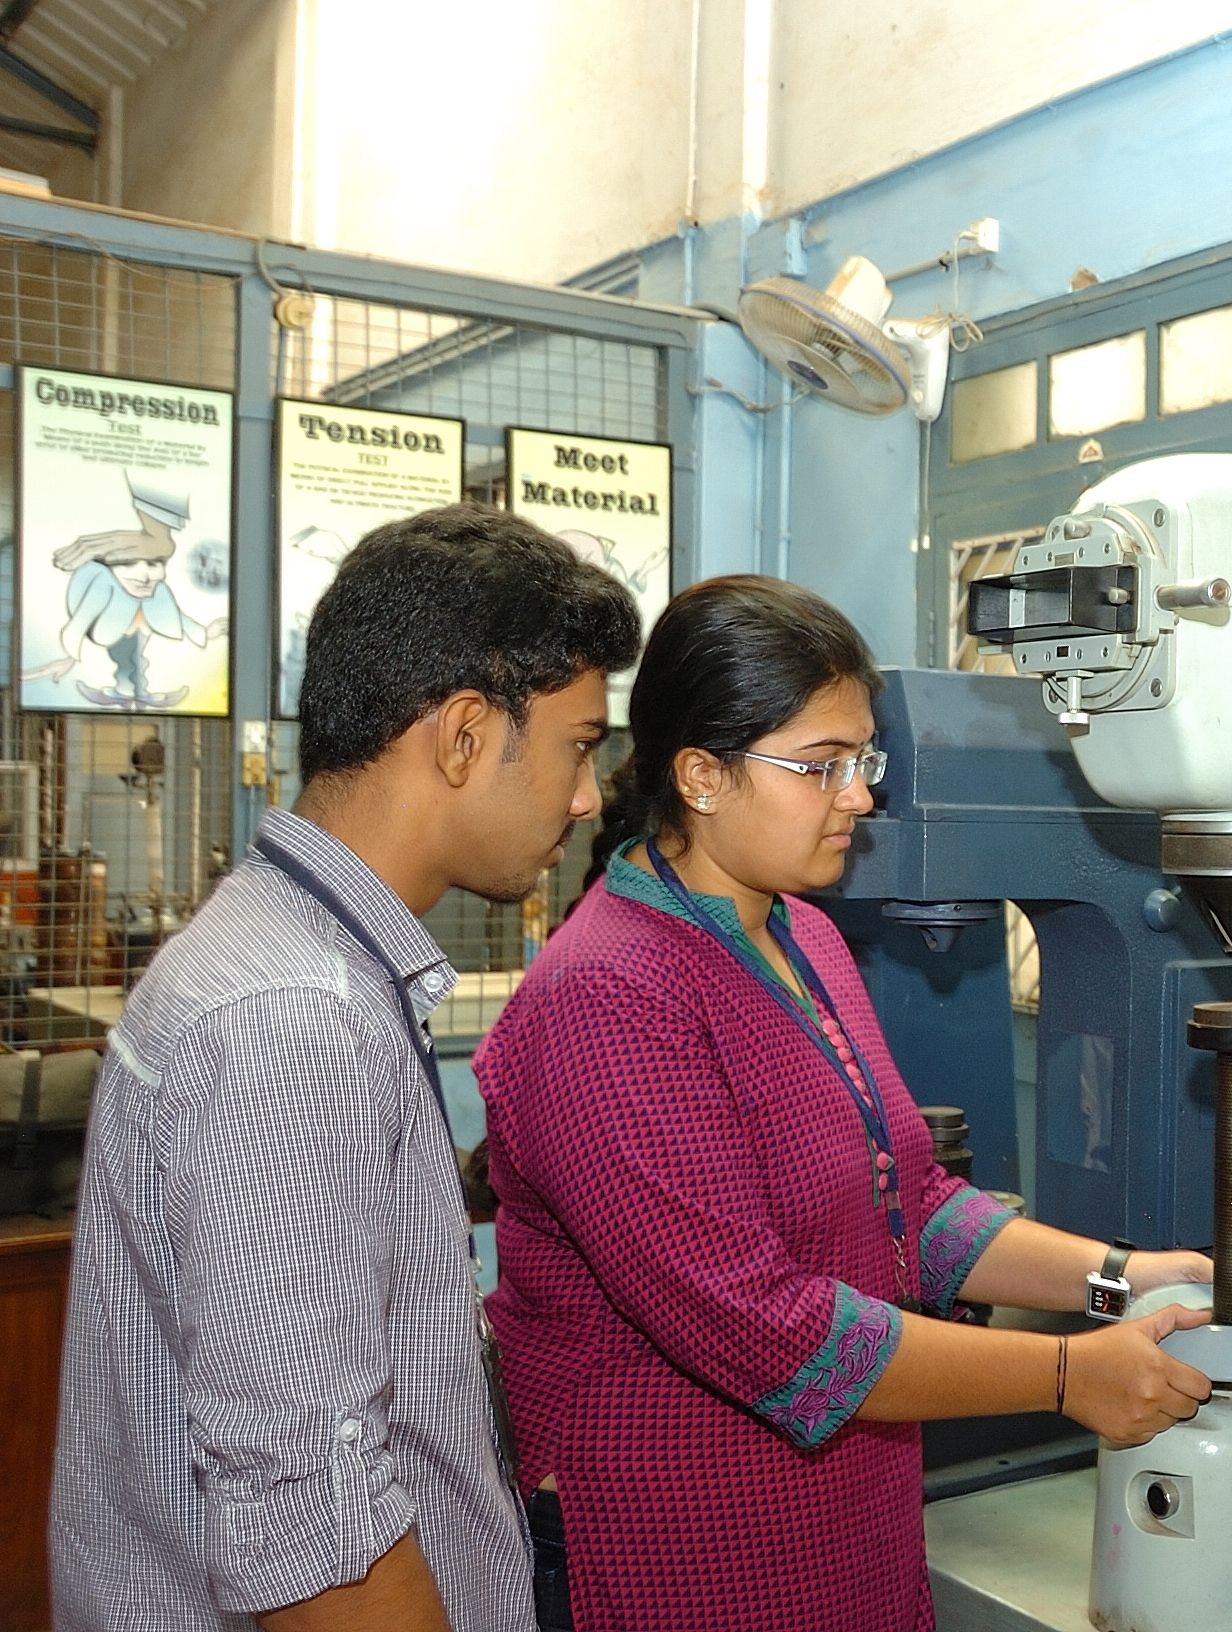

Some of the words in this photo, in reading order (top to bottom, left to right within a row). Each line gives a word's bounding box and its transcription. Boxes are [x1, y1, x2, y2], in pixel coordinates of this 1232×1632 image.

[35, 375, 220, 427] Compression
[297, 413, 445, 455] Tension
[553, 444, 630, 476] Meet
[521, 478, 661, 517] Material
